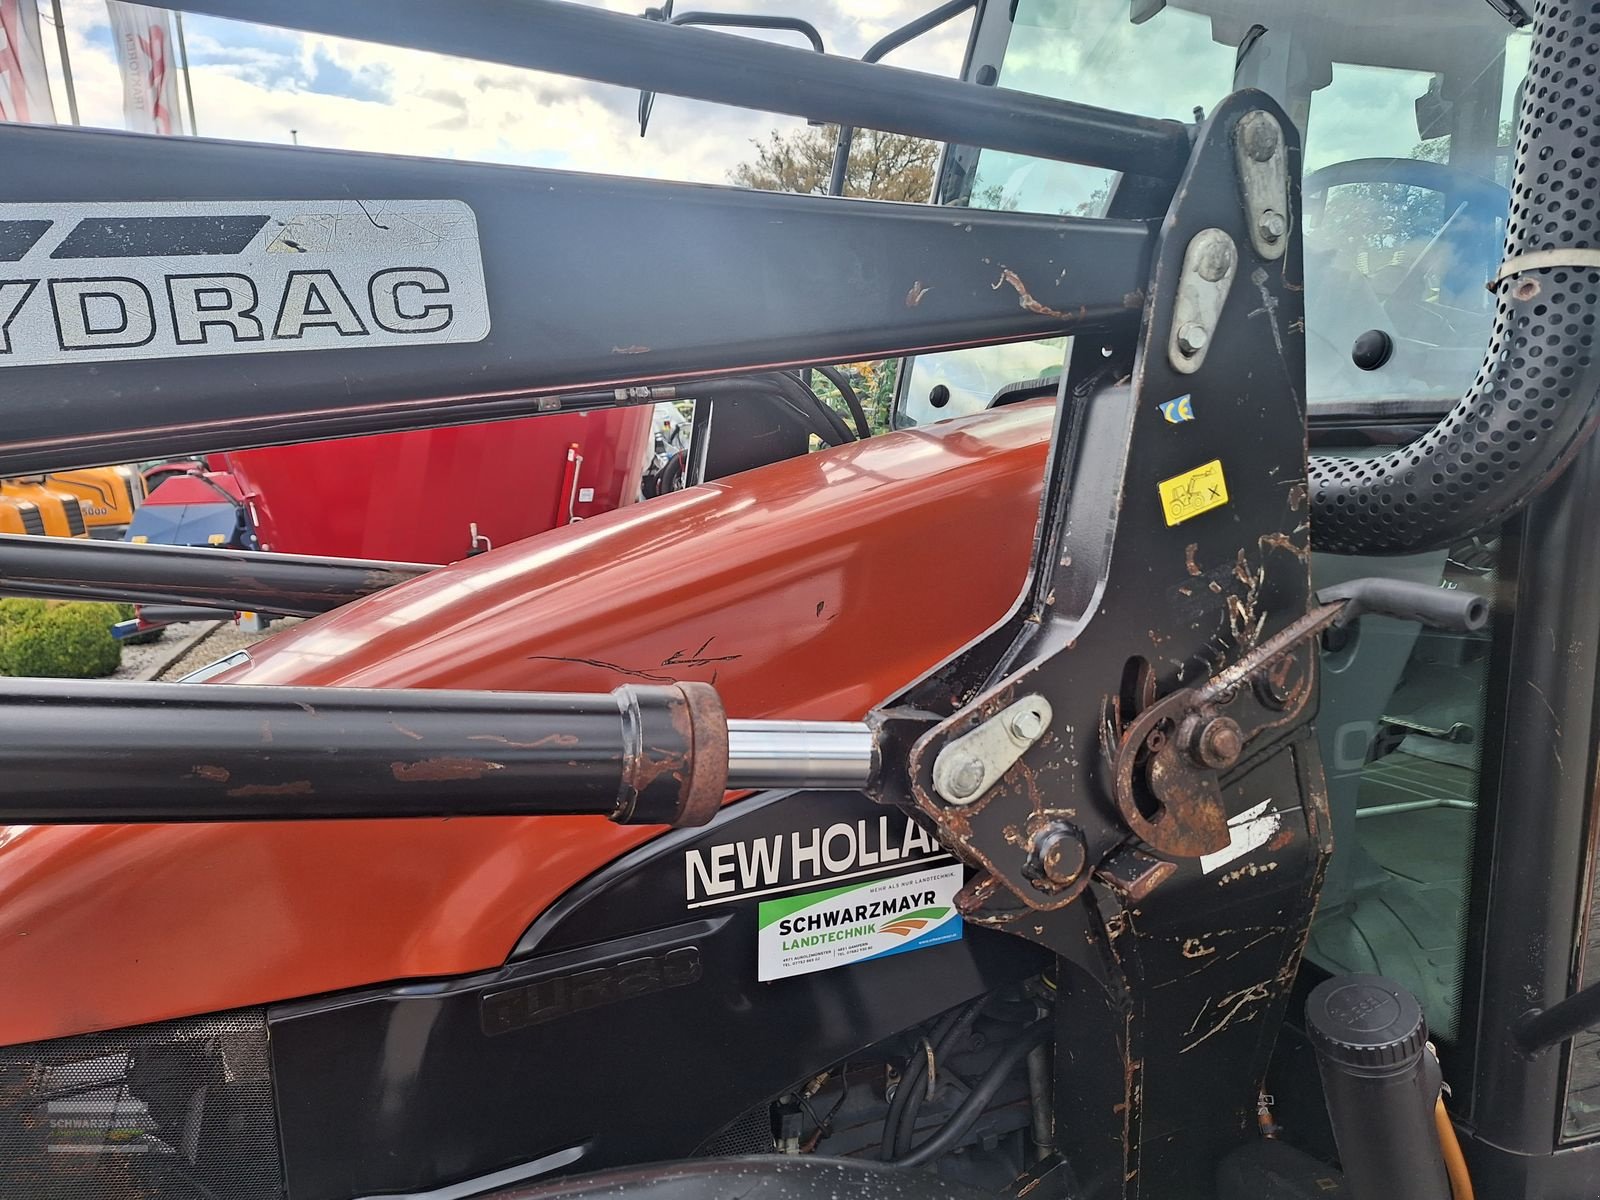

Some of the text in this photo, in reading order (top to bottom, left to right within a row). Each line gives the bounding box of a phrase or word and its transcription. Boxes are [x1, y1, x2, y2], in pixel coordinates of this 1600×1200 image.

[685, 815, 939, 900] NEW HOLLA
[778, 890, 936, 936] SCHWARZMAYR
[781, 922, 876, 951] LANDTECHNIK
